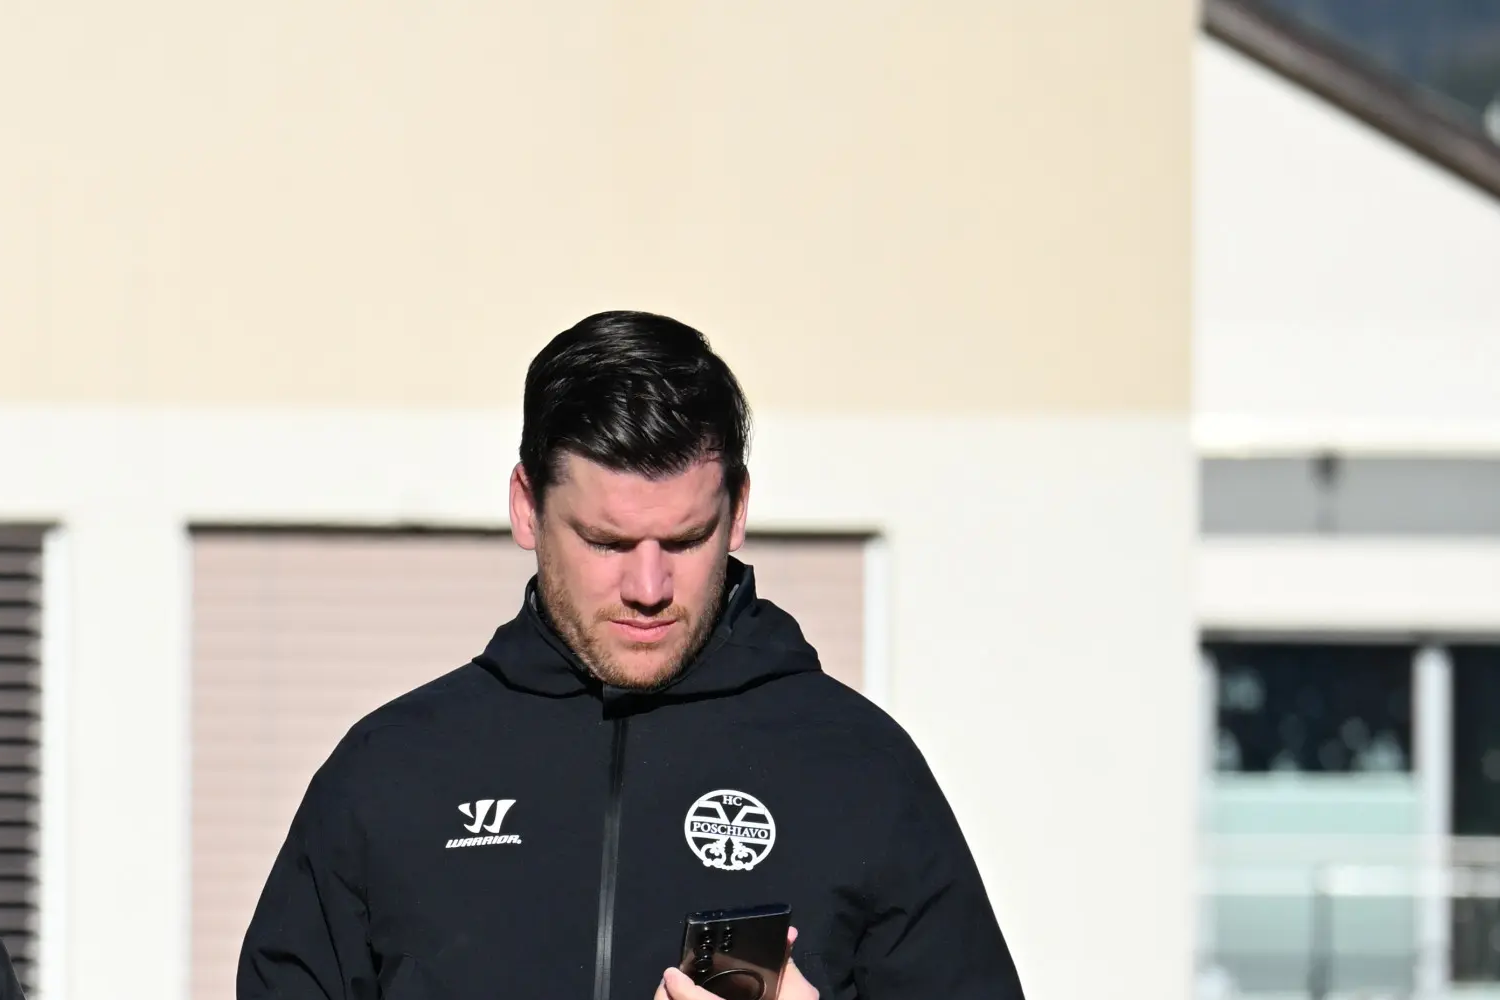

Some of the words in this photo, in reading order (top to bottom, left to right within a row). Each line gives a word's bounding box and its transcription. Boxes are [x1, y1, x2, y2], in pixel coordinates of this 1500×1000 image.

[722, 795, 743, 806] HC
[692, 822, 769, 839] POSCHIAVO
[445, 835, 520, 849] WARRIOR
